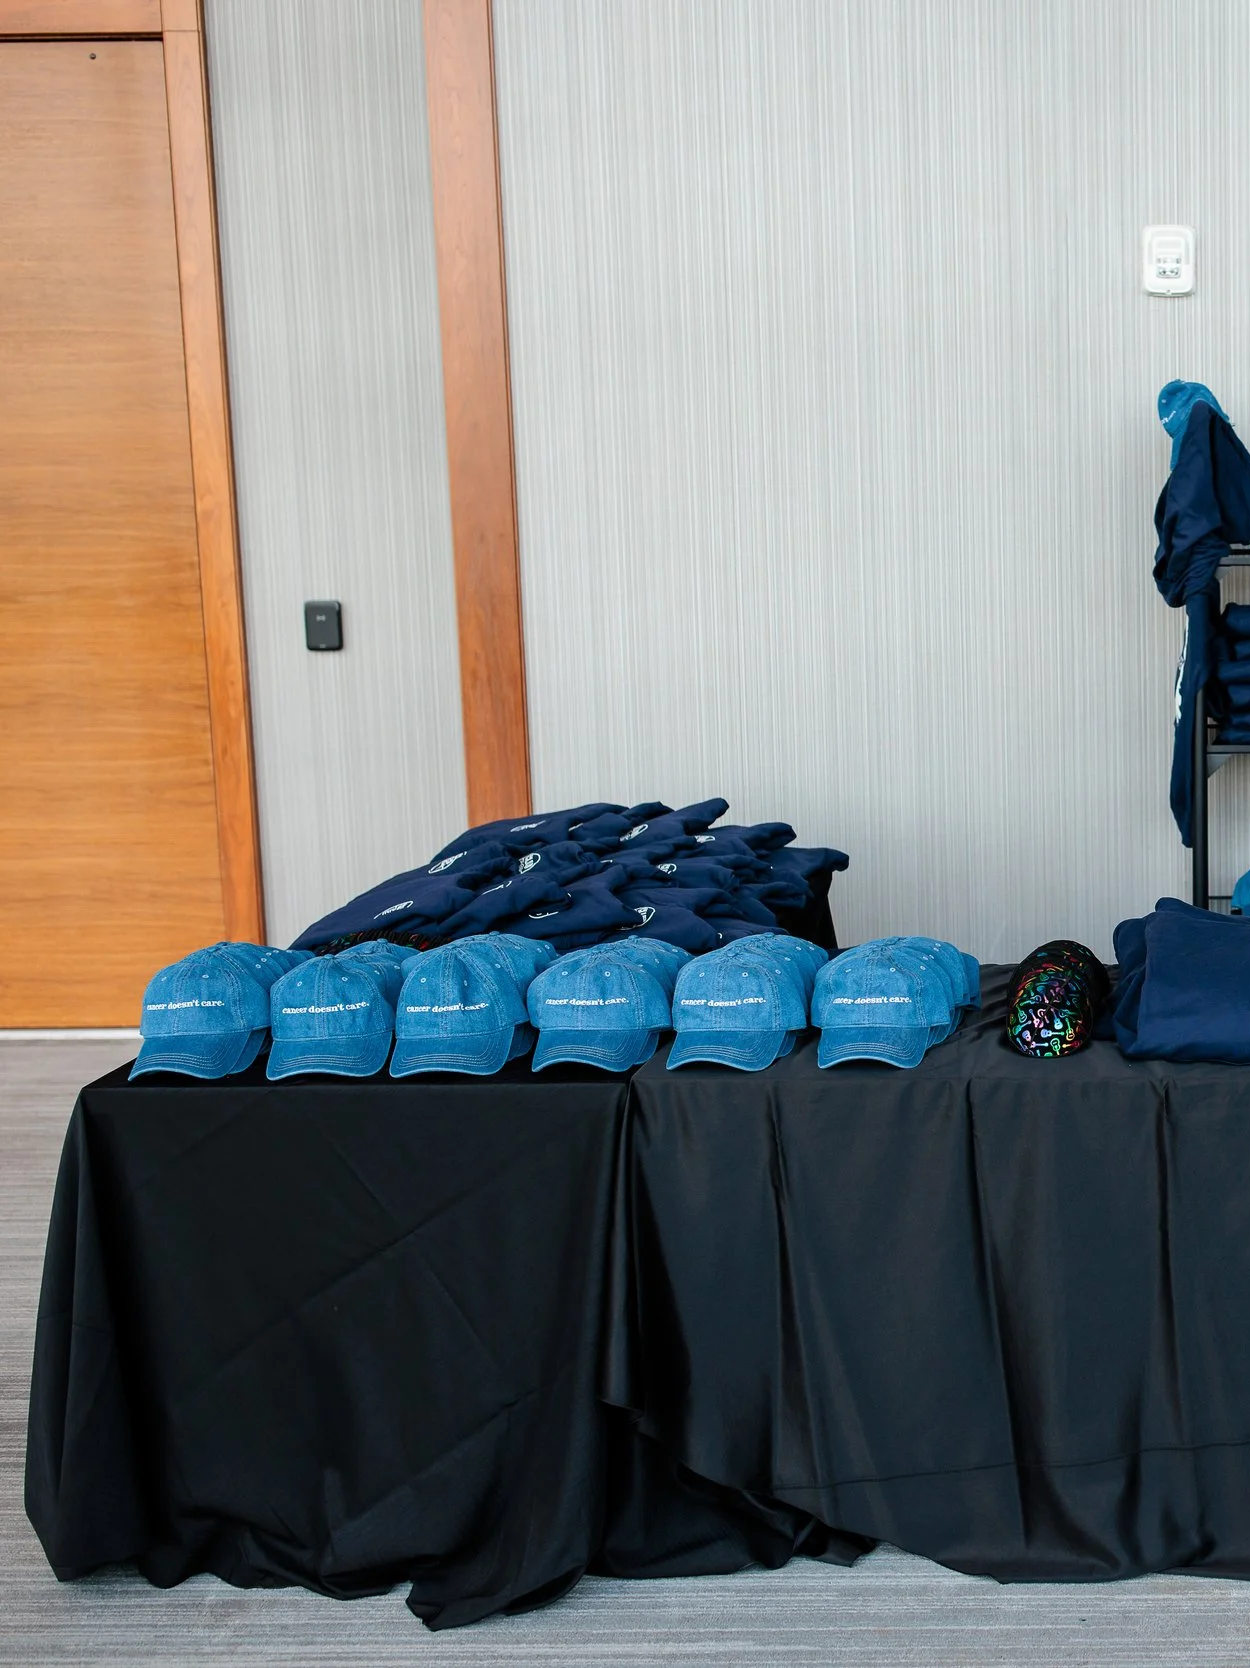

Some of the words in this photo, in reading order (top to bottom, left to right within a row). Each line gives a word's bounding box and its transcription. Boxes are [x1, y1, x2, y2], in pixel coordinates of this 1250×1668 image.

[167, 999, 200, 1010] doesn't
[568, 998, 605, 1006] doesn't
[604, 997, 630, 1005] care.
[707, 999, 742, 1007] doesn't
[854, 996, 889, 1005] doesn't
[888, 996, 913, 1004] care.
[281, 1006, 308, 1014] cancer
[308, 1003, 345, 1013] doesn't
[345, 1001, 370, 1010] care.
[406, 1005, 432, 1013] cancer
[431, 1002, 465, 1013] doesn't
[464, 1002, 489, 1011] care.
